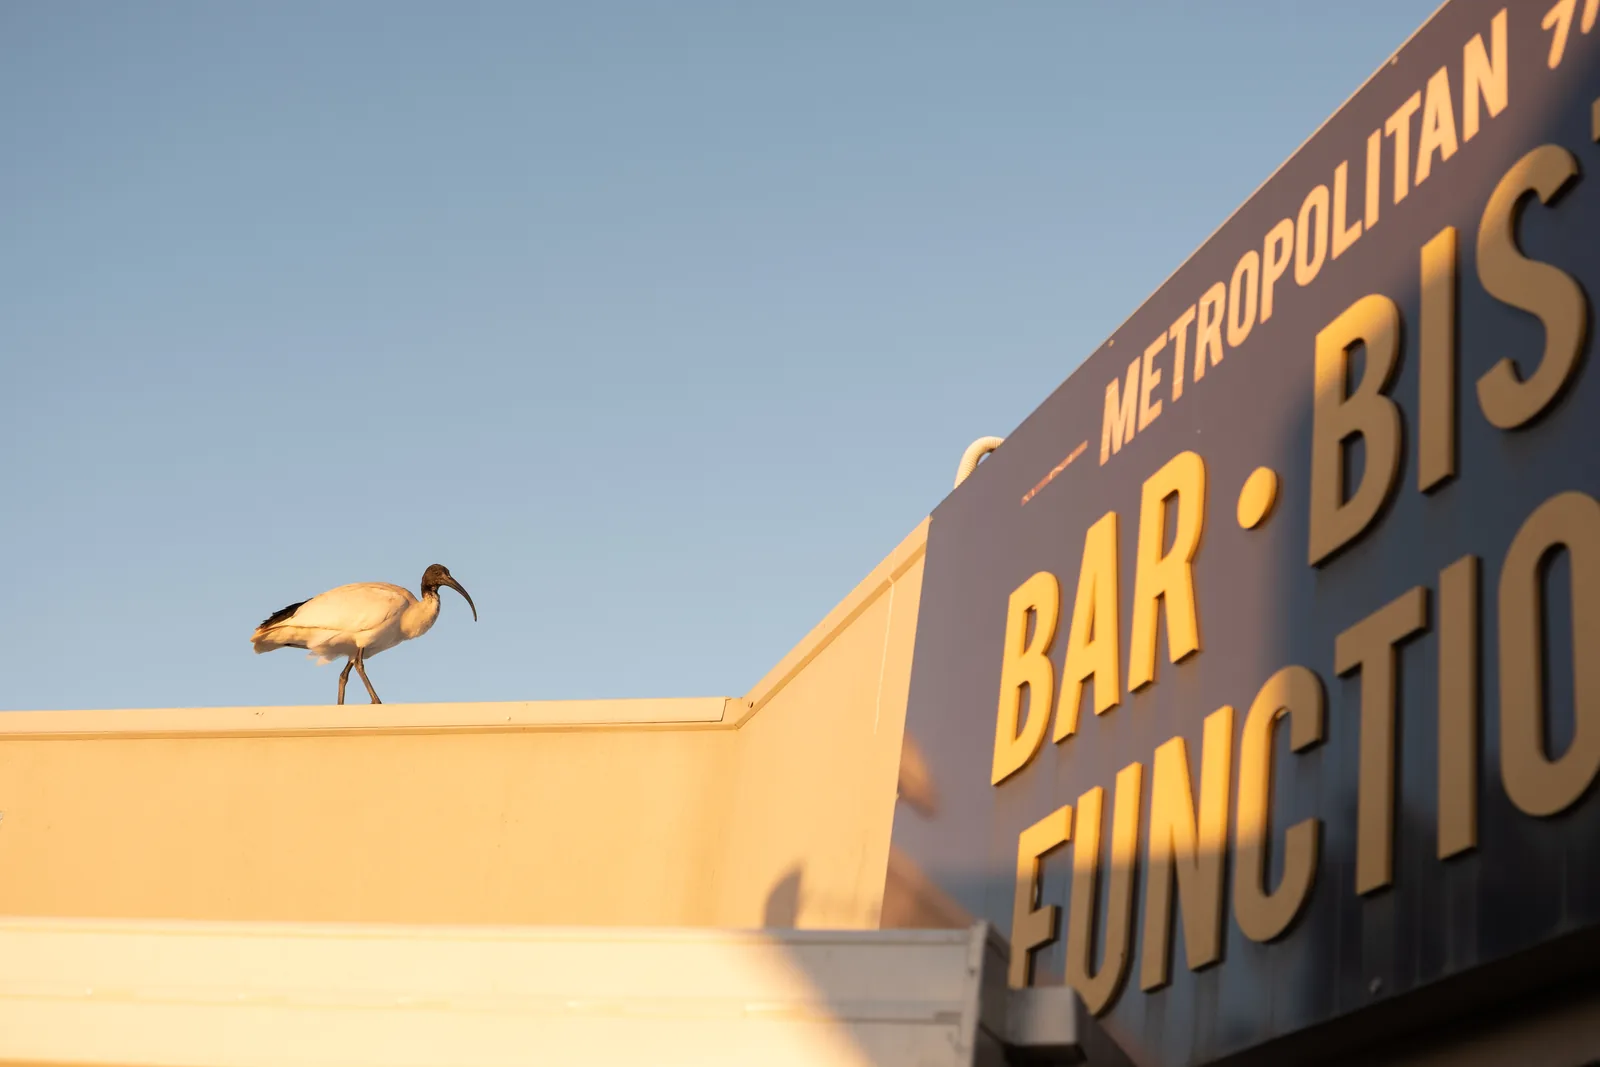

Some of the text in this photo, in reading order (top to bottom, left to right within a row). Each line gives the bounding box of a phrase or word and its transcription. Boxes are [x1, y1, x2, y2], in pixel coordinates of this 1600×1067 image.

[991, 97, 1600, 787] BAR BIS
[1100, 7, 1508, 467] METROPOLITAN
